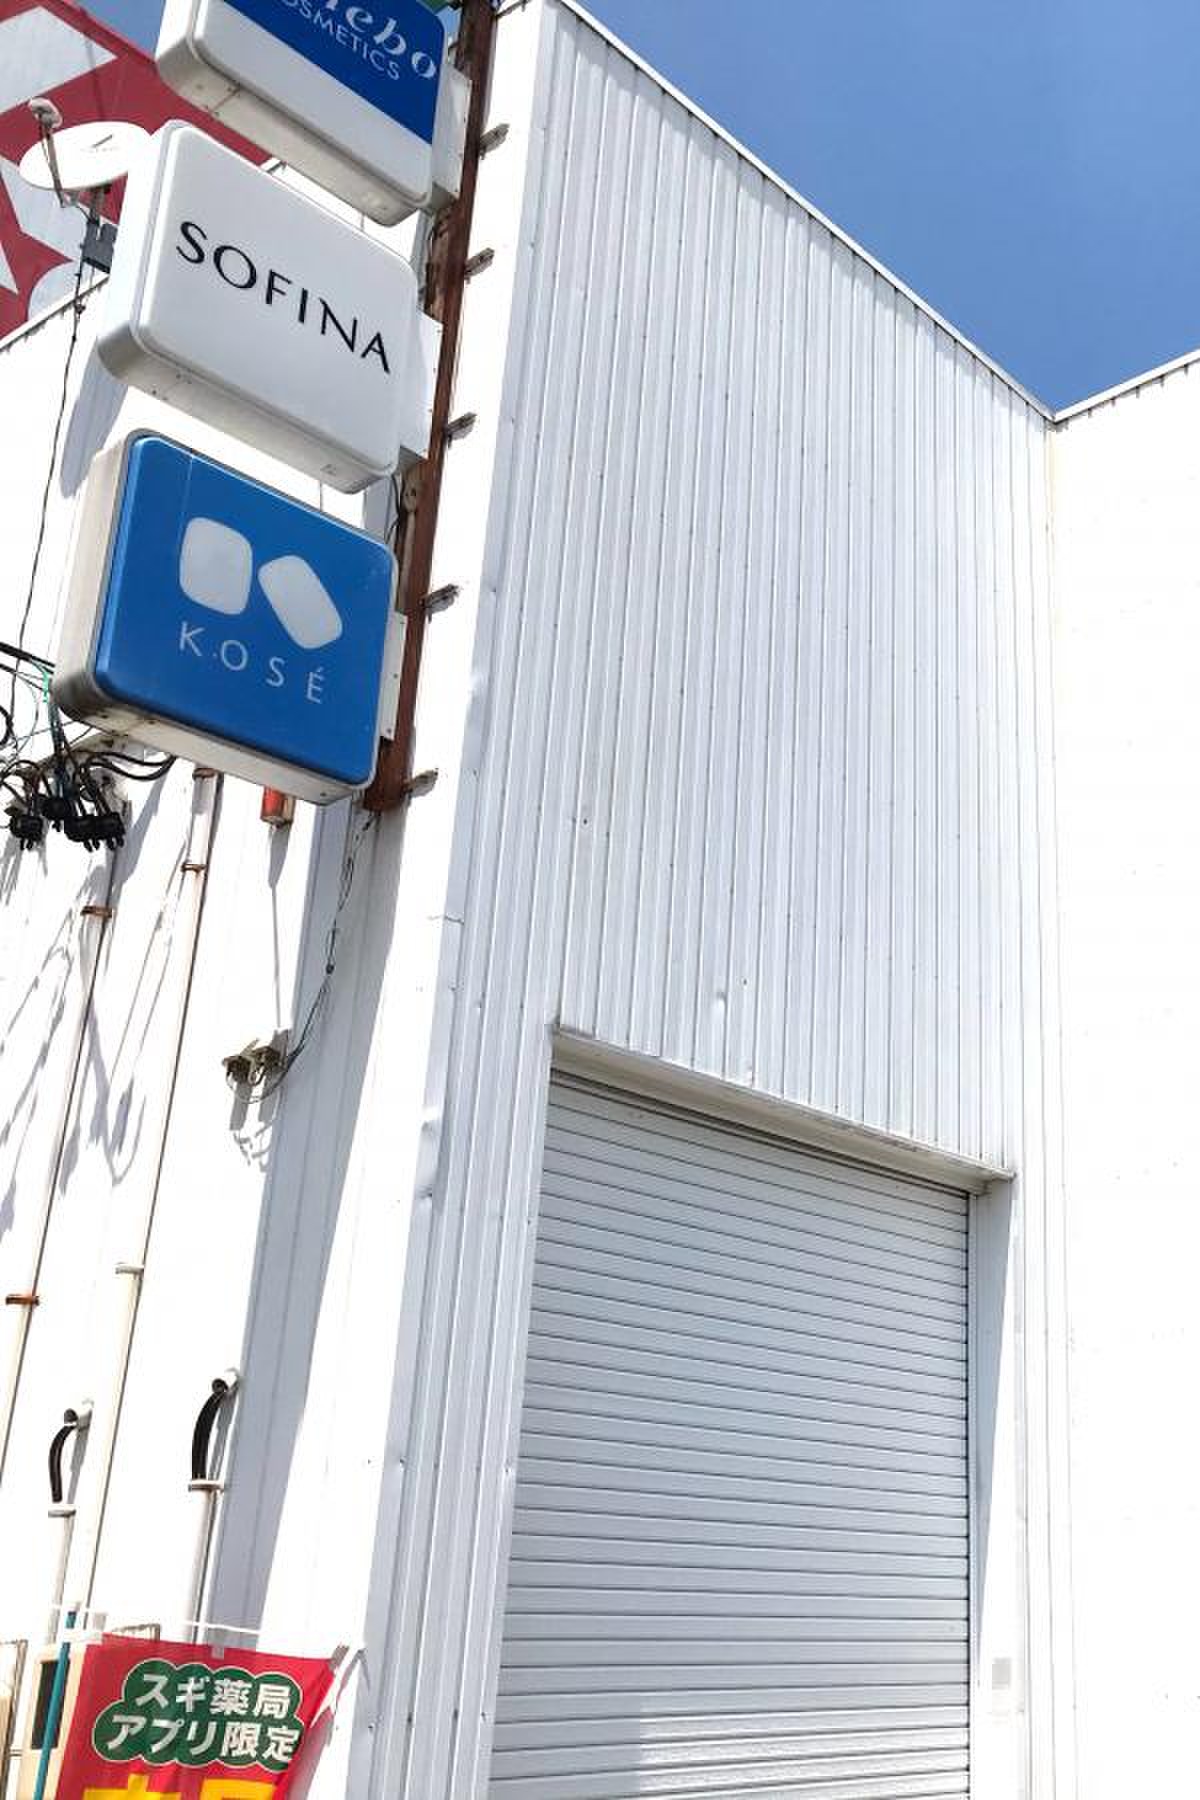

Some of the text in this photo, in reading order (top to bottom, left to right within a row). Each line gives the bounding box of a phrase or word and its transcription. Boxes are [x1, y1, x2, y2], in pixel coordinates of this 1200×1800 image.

[324, 0, 437, 78] ebo
[177, 221, 391, 374] SOFINA
[179, 621, 325, 703] KOSÉ
[135, 1672, 292, 1720] スギ薬局
[106, 1714, 300, 1762] アプリ限定
